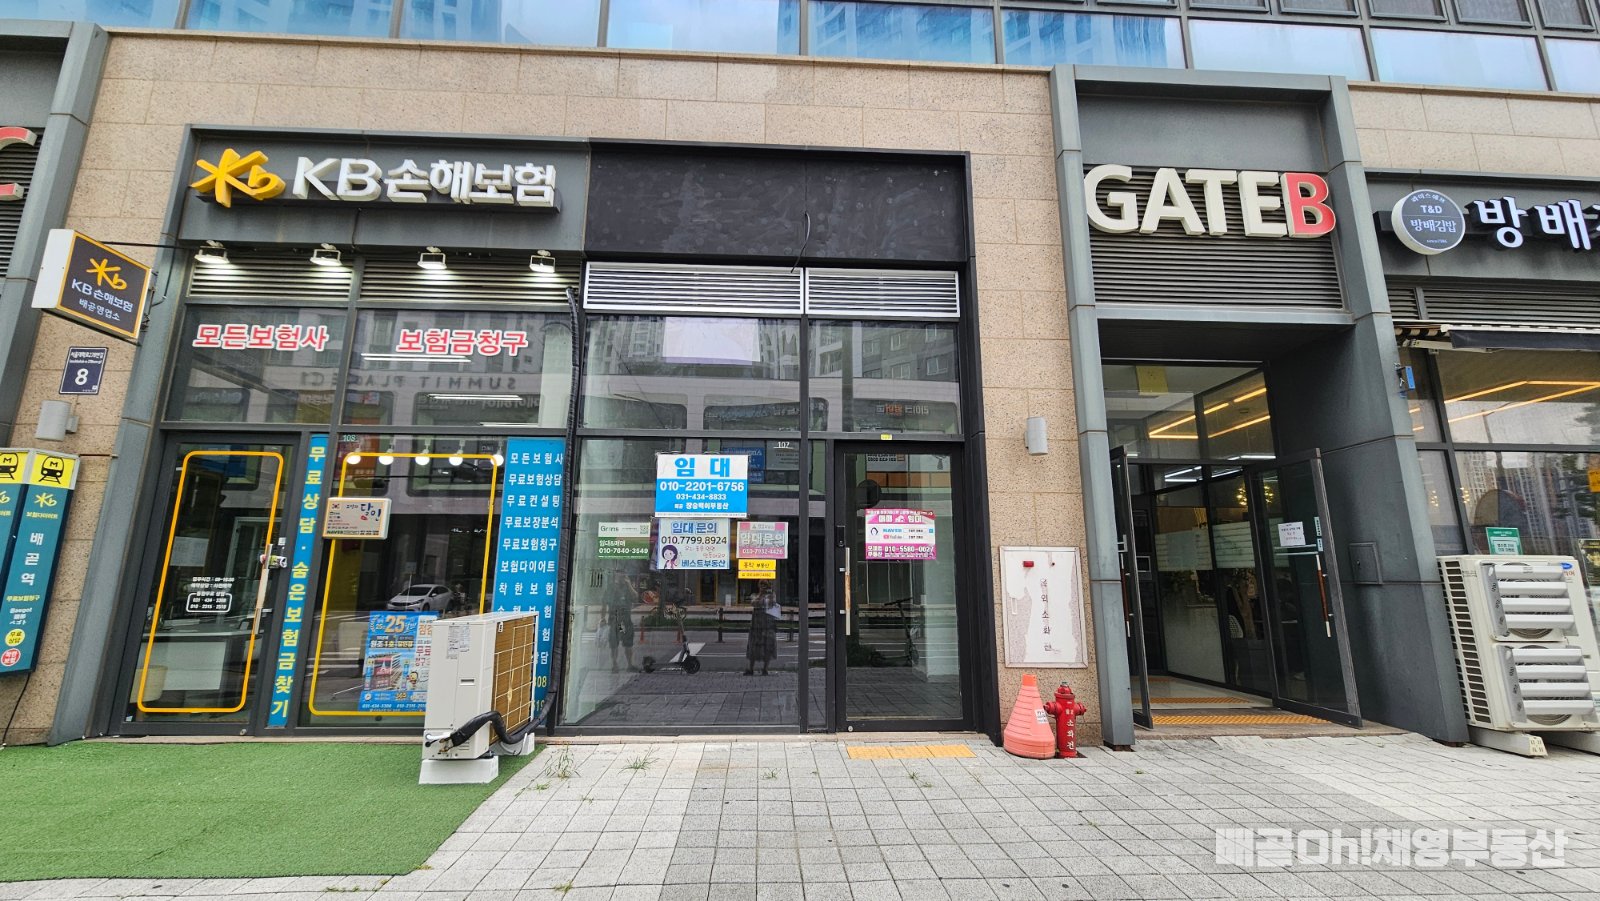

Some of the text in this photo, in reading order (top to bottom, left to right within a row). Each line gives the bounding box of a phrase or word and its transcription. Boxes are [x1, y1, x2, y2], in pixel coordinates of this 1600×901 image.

[292, 157, 557, 207] KB손해보험
[1420, 205, 1443, 214] T&D
[1410, 219, 1457, 233] 방배김밥
[1473, 196, 1600, 250] 방배
[71, 278, 134, 313] KB손해보험
[193, 325, 328, 351] 모든보험사
[396, 329, 528, 356] 보험금청구
[75, 368, 89, 385] 8
[510, 452, 564, 465] 모든보험사
[674, 457, 730, 478] 임대
[508, 473, 562, 486] 무료보험상담
[659, 481, 745, 492] 010-2201-6756
[299, 446, 327, 535] 무료상담
[507, 494, 560, 508] 무료컨설팅
[504, 516, 559, 529] 무료보장분석
[672, 522, 717, 534] 임대 문의
[502, 538, 557, 551] 무료보험청구
[661, 536, 727, 545] 010.7799.8924
[500, 560, 555, 573] 보험다이어트
[681, 559, 726, 567] 베스트부동산
[498, 582, 554, 596] 착한보험
[384, 615, 407, 633] 25
